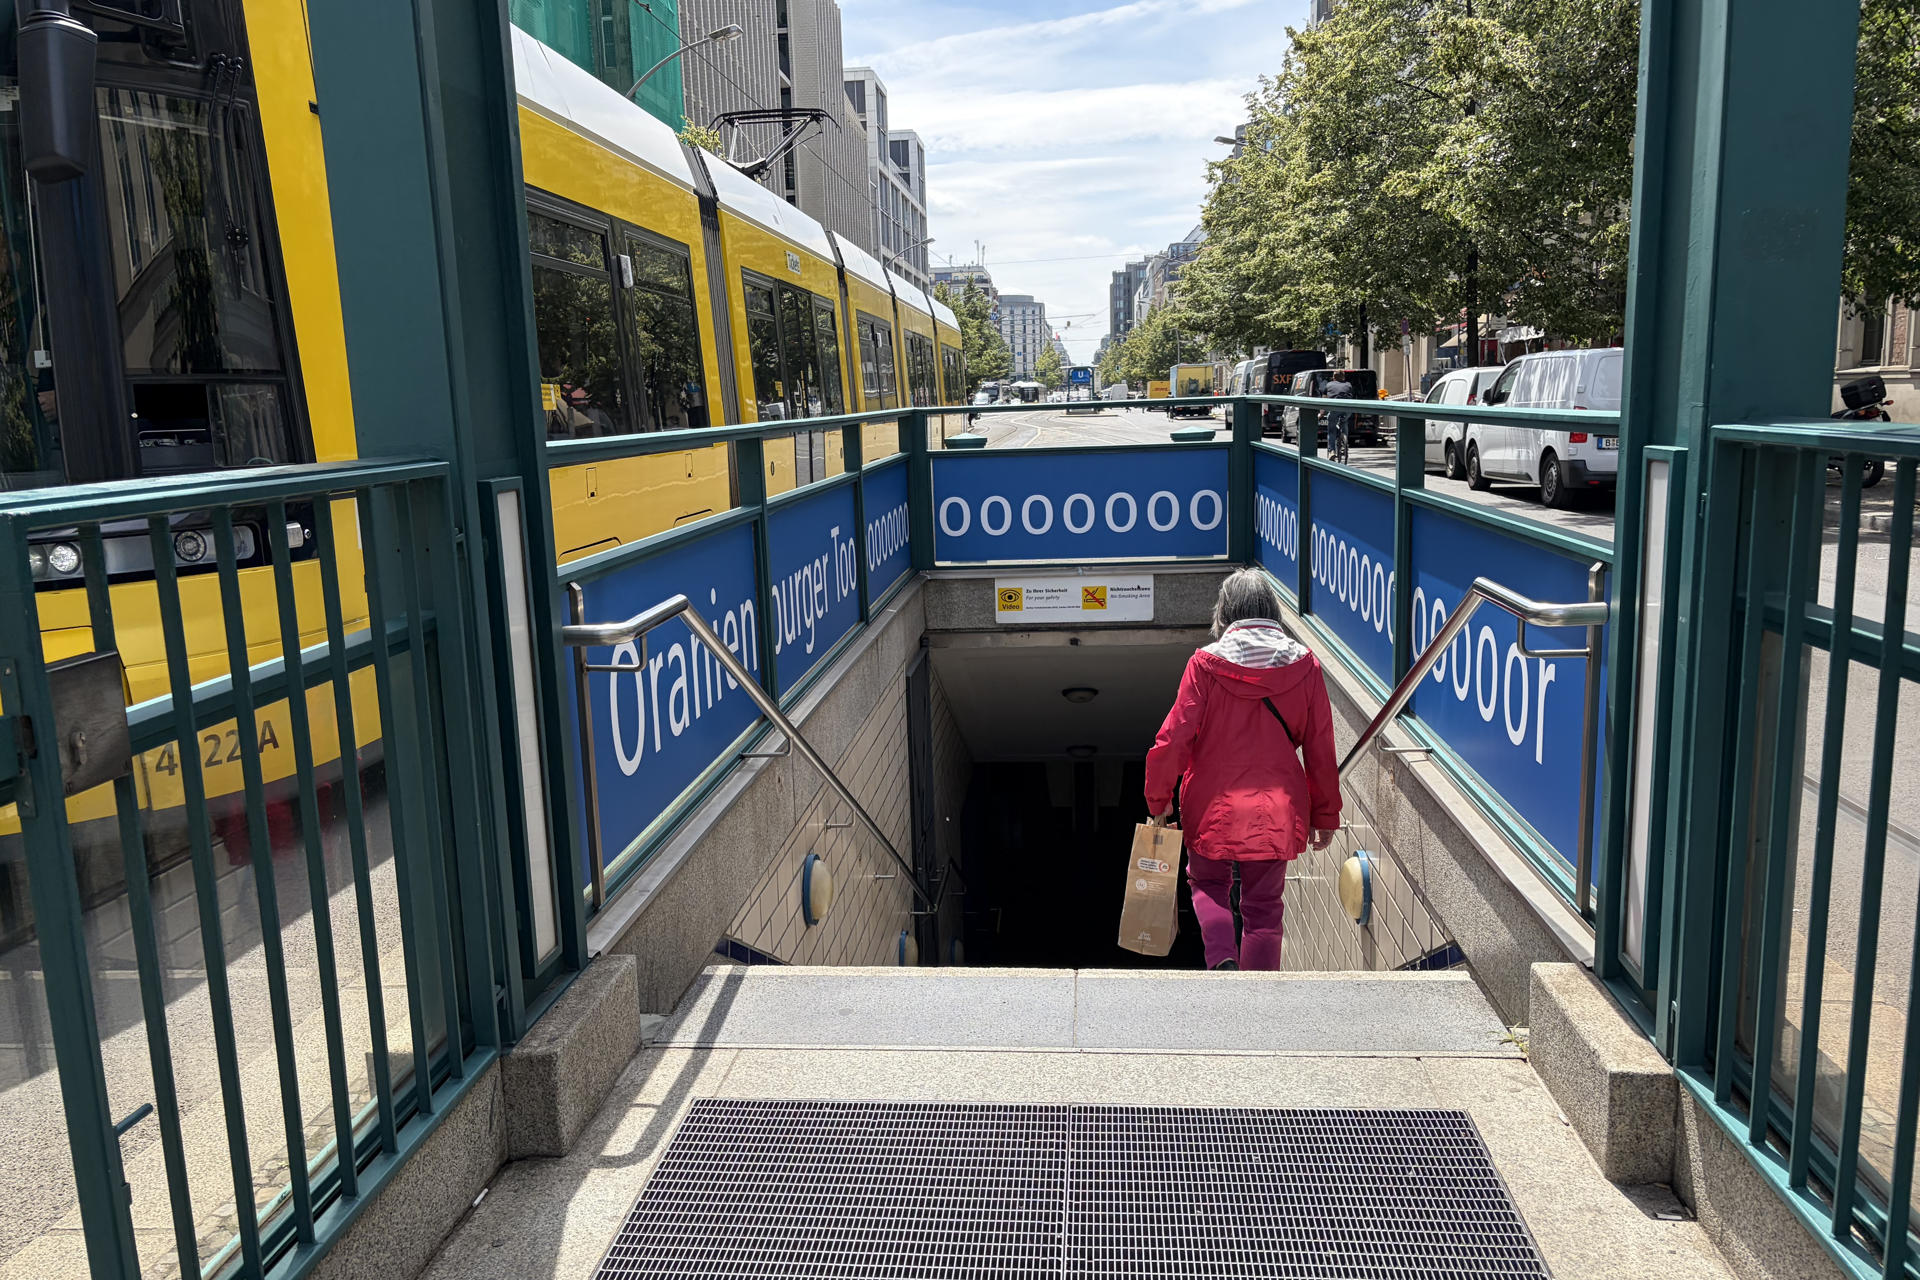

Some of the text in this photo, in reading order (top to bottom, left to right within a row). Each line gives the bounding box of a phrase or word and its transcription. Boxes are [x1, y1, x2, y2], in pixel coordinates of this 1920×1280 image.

[865, 501, 910, 573] ooooooo
[1254, 491, 1299, 562] ooooooo
[610, 587, 759, 777] Oranien
[831, 525, 857, 602] Too
[155, 720, 280, 777] 422 A
